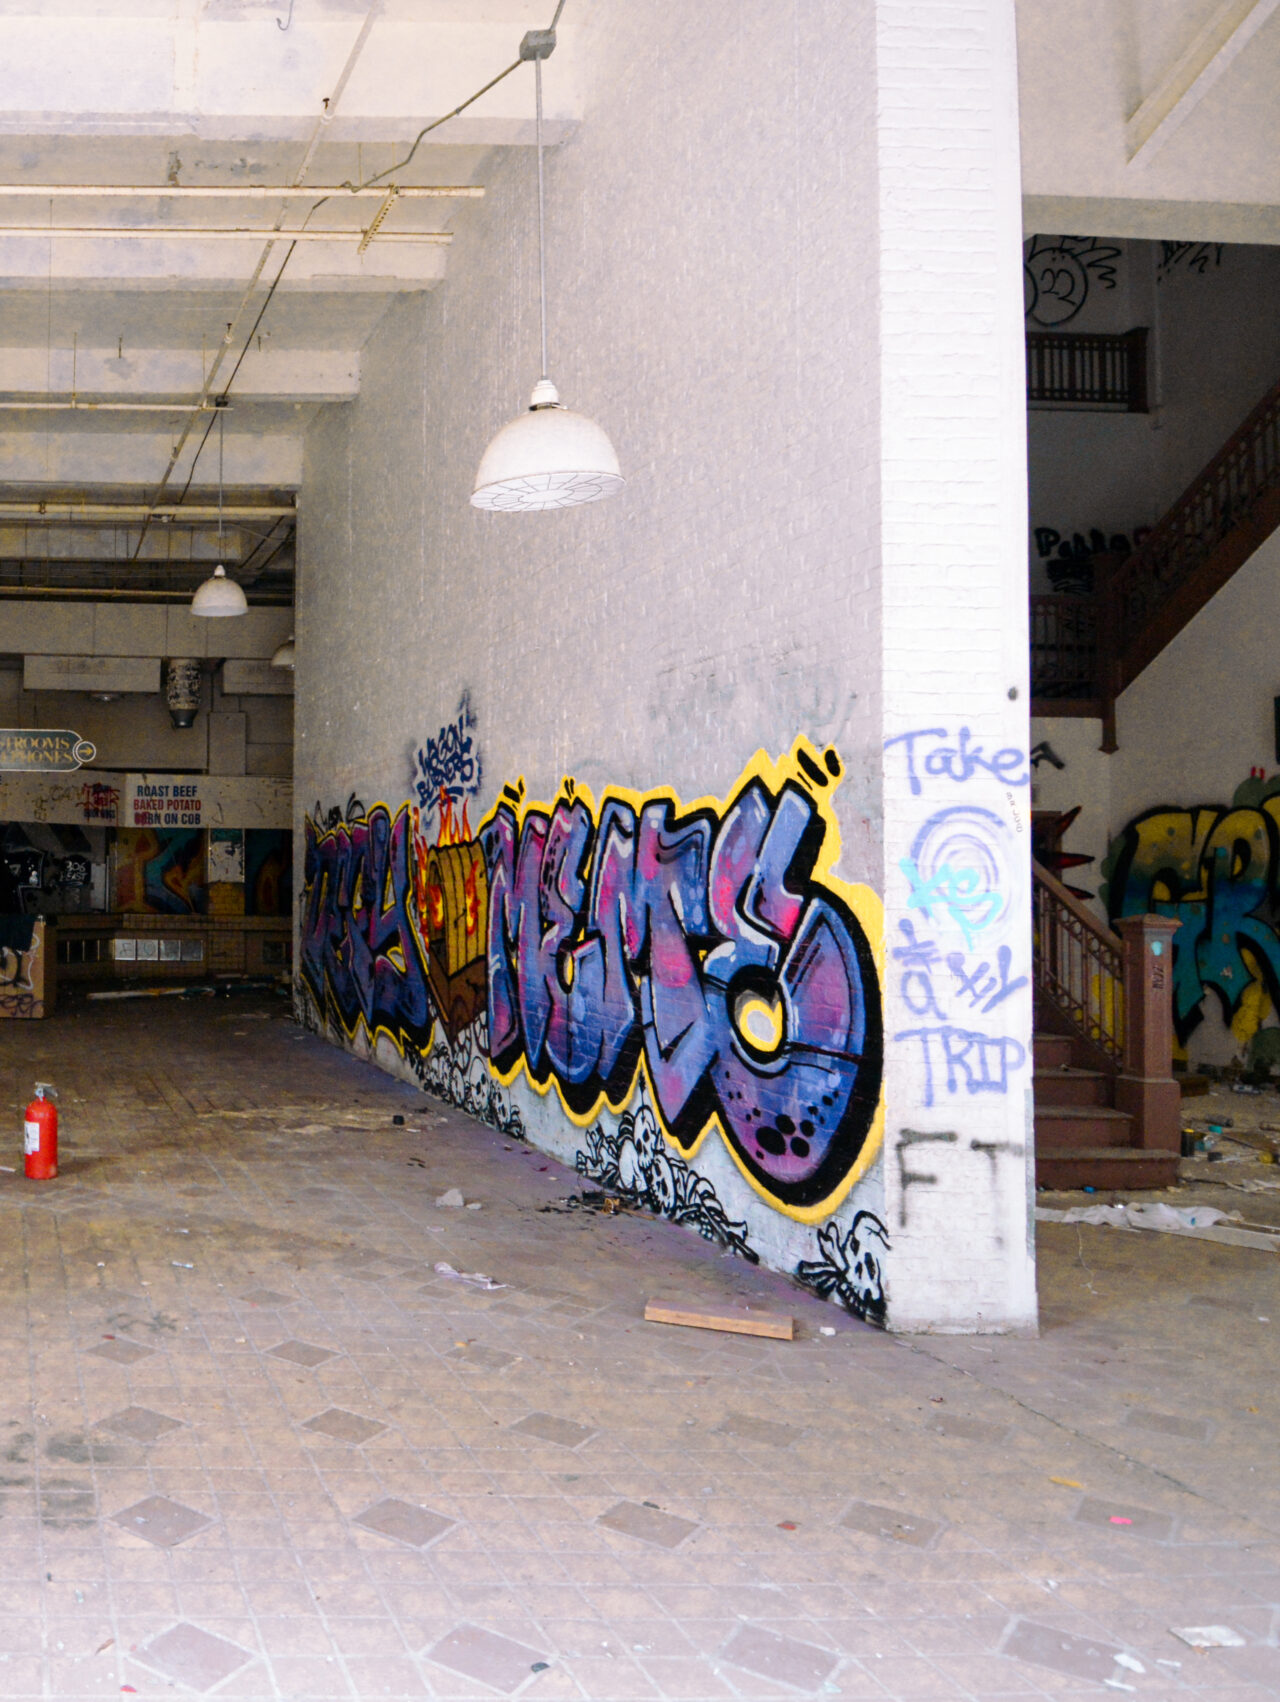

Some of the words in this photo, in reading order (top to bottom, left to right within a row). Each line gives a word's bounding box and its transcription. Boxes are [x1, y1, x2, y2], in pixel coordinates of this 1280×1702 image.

[883, 726, 1029, 796] Take
[137, 785, 169, 797] ROAST
[173, 785, 197, 797] BEEF
[134, 799, 164, 811] BAKED
[167, 799, 202, 811] POTATO
[165, 813, 178, 825] ON
[181, 813, 201, 825] COB
[893, 1026, 1026, 1108] TRIP
